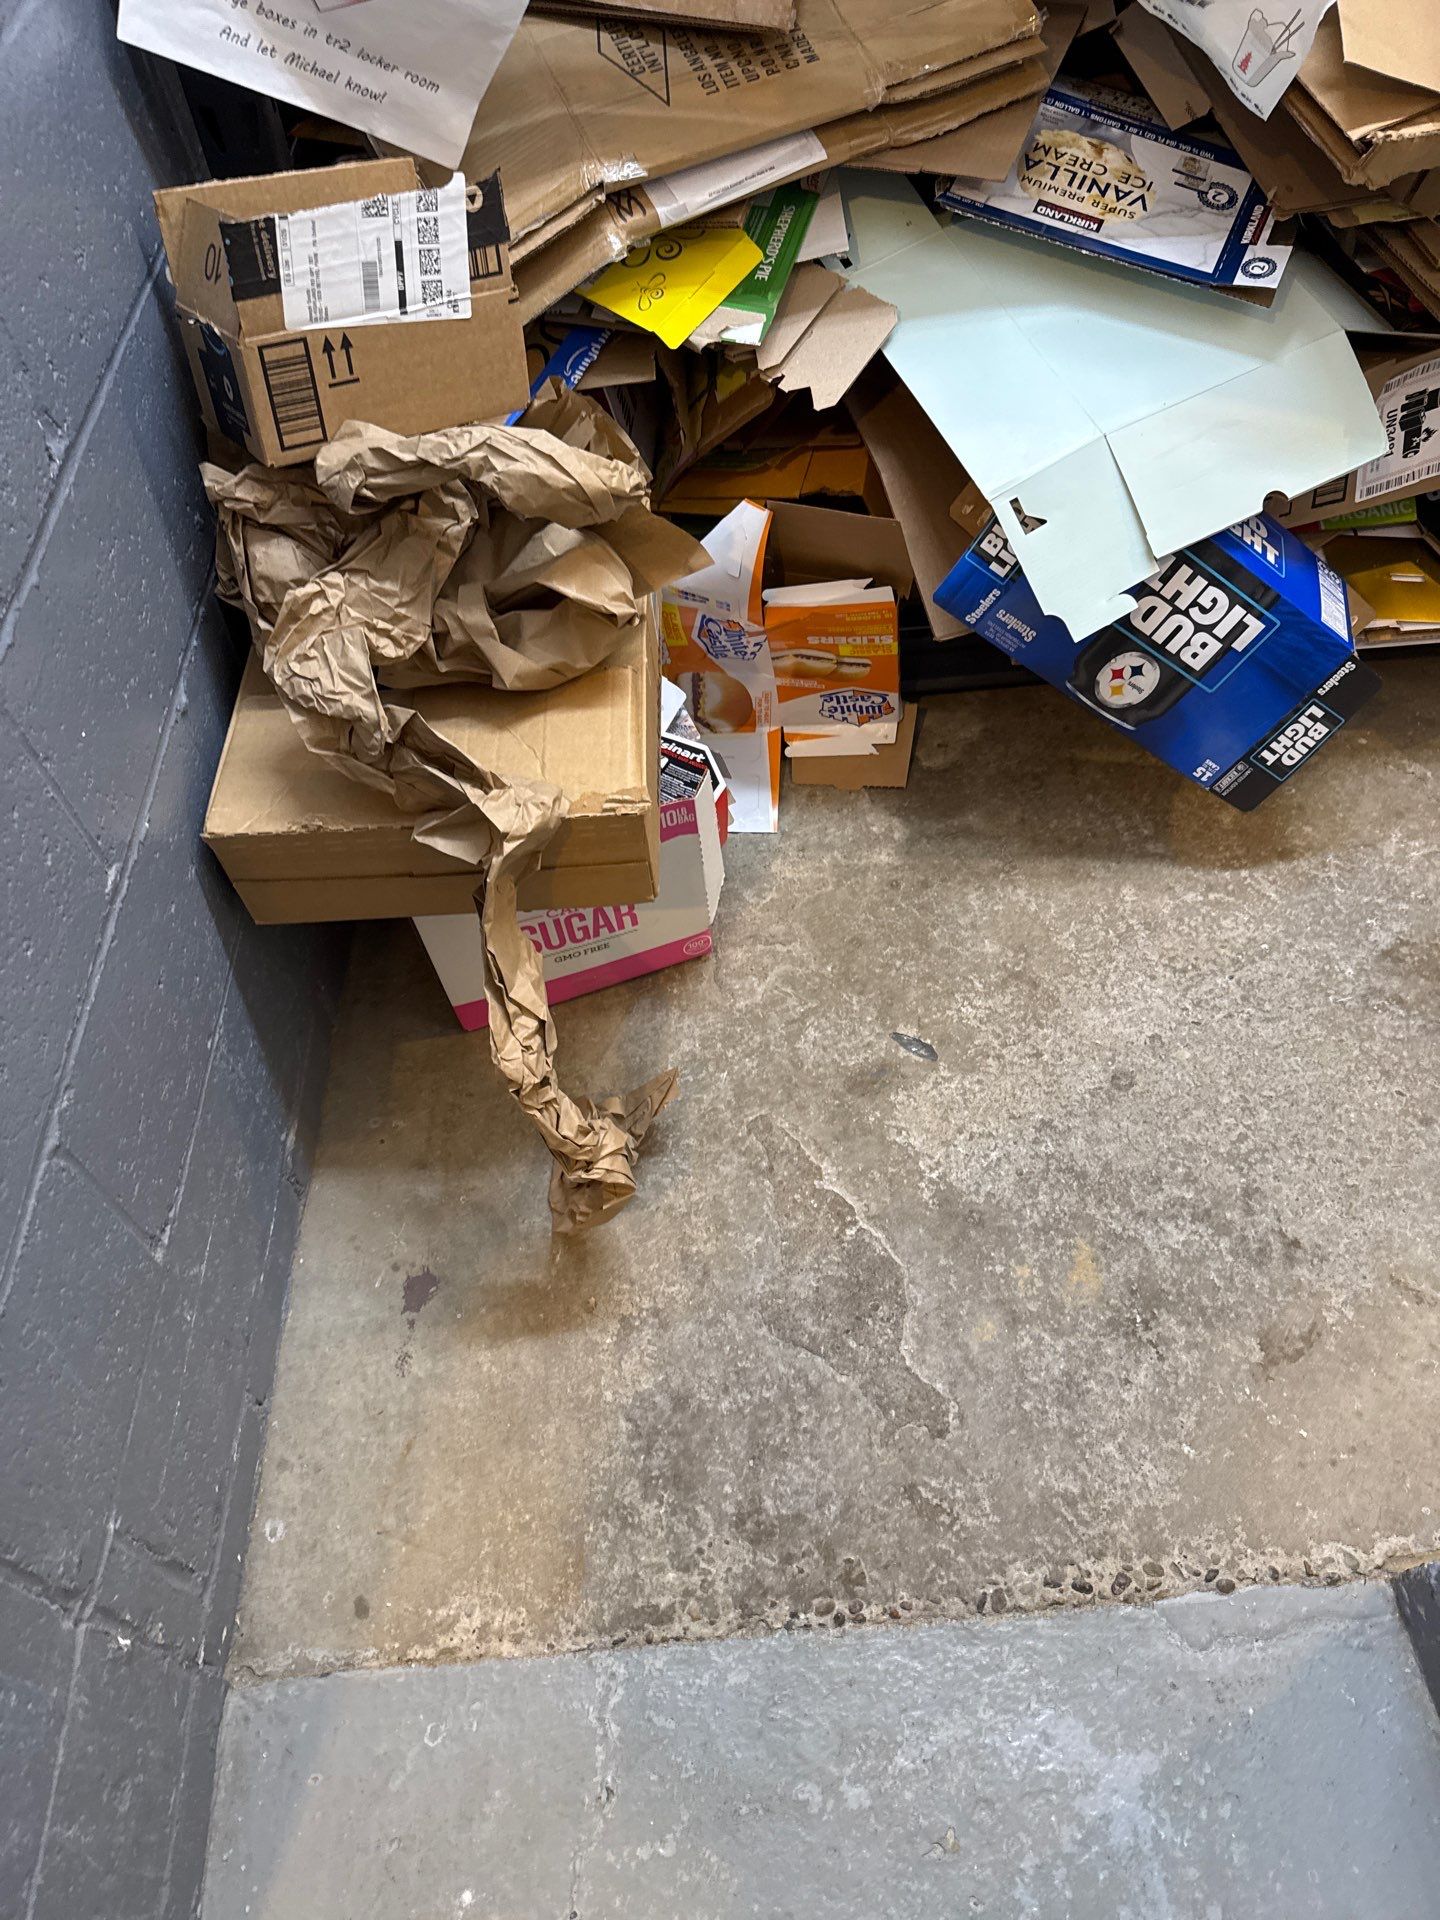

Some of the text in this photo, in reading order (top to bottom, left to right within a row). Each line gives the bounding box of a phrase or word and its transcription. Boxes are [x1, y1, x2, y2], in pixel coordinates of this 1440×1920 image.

[256, 1, 296, 30] boxes
[303, 22, 318, 39] in
[325, 32, 351, 54] tr2
[356, 47, 400, 73] locker
[404, 71, 440, 94] room
[604, 22, 647, 77] CERTIFIE
[671, 28, 721, 96] LOS ANGELE
[791, 33, 820, 64] MADE
[219, 24, 387, 104] And let Michael know!
[714, 61, 741, 90] ITEM
[737, 58, 761, 83] UPC
[1054, 101, 1081, 117] GALLON
[1090, 114, 1121, 130] CARTONS
[1033, 142, 1154, 192] ICE CREAM
[1200, 149, 1215, 160] TWO
[1021, 175, 1136, 219] SUPER PREMIUM
[1024, 153, 1148, 212] VANILLA
[1211, 190, 1224, 202] 2
[1036, 205, 1099, 231] KIRKLAND
[1240, 204, 1264, 244] KIRKLAND
[762, 205, 796, 268] SHEPHERD'S
[754, 264, 769, 281] PIE
[965, 588, 1001, 624] Steelers
[807, 635, 894, 644] SLIDERS
[996, 609, 1037, 643] Steelers
[1130, 595, 1223, 672] BUD
[1317, 661, 1357, 696] Steelers
[822, 694, 888, 705] Castle
[827, 703, 882, 716] White
[1260, 704, 1326, 766] LIGHT
[1281, 722, 1330, 766] BUD
[661, 740, 706, 764] sinart
[1206, 758, 1221, 772] CANS
[1192, 766, 1214, 782] 15
[661, 809, 677, 828] 10
[679, 813, 695, 824] BAG
[546, 906, 580, 919] CA
[519, 903, 639, 954] SUGAR
[554, 942, 611, 964] GMO FREE
